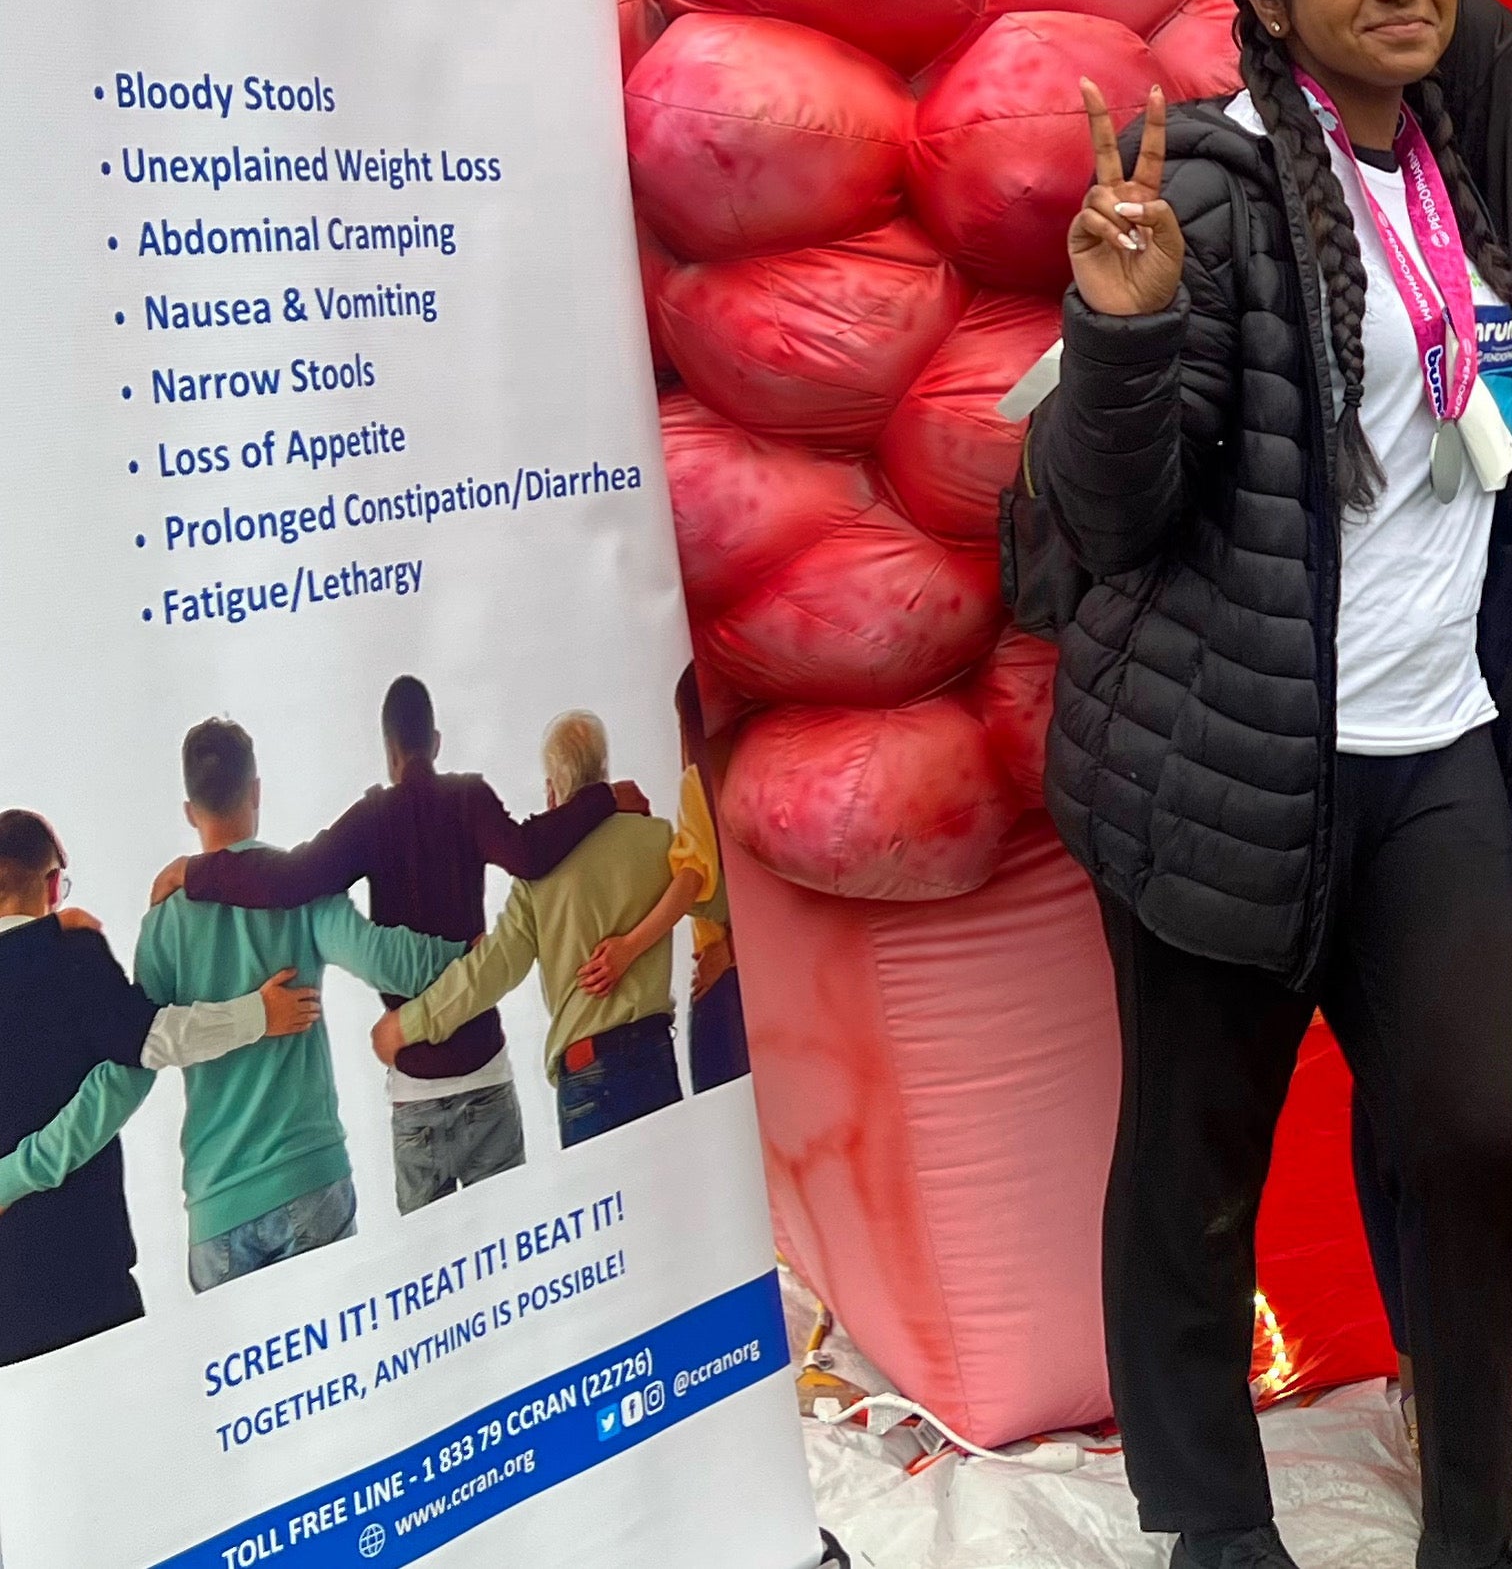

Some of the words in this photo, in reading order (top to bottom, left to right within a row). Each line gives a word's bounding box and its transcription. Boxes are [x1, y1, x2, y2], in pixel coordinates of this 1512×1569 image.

[116, 71, 233, 118] Bloody
[243, 75, 335, 113] Stools
[122, 145, 328, 191] Unexplained
[335, 148, 433, 190] Weight
[440, 151, 501, 183] Loss
[1407, 147, 1442, 231] PENDOPHARM
[138, 216, 319, 258] Abdominal
[326, 216, 456, 257] Cramping
[144, 287, 271, 331] Nausea
[282, 287, 305, 323] &
[315, 283, 437, 323] Vomiting
[1386, 227, 1433, 323] PENDOPHARM
[151, 364, 280, 404] Narrow
[290, 352, 376, 393] Stools
[158, 440, 230, 478] Loss
[241, 432, 275, 470] of
[286, 421, 406, 469] Appetite
[165, 496, 336, 550] Prolonged
[343, 461, 641, 528] Constipation/Diarrhea
[163, 557, 423, 625] Fatigue/Lethargy
[204, 1317, 328, 1398] SCREEN
[338, 1298, 379, 1343] IT!
[385, 1266, 467, 1321] TREAT
[473, 1241, 508, 1284] IT!
[515, 1216, 586, 1264] BEAT
[592, 1190, 625, 1231] IT!
[215, 1373, 368, 1453] TOGETHER,
[374, 1310, 487, 1385] ANYTHING
[491, 1298, 512, 1330] IS
[516, 1250, 627, 1319] POSSIBLE!
[672, 1336, 760, 1398] @ccranorg
[222, 1528, 284, 1569] TOLL
[289, 1497, 348, 1545] FREE
[353, 1471, 405, 1515] LINE
[422, 1456, 435, 1484] 1
[439, 1435, 474, 1475] 833
[477, 1421, 502, 1456] 79
[505, 1384, 577, 1438] CCRAN
[581, 1346, 654, 1406] (22726)
[394, 1446, 536, 1537] www.ccran.org
